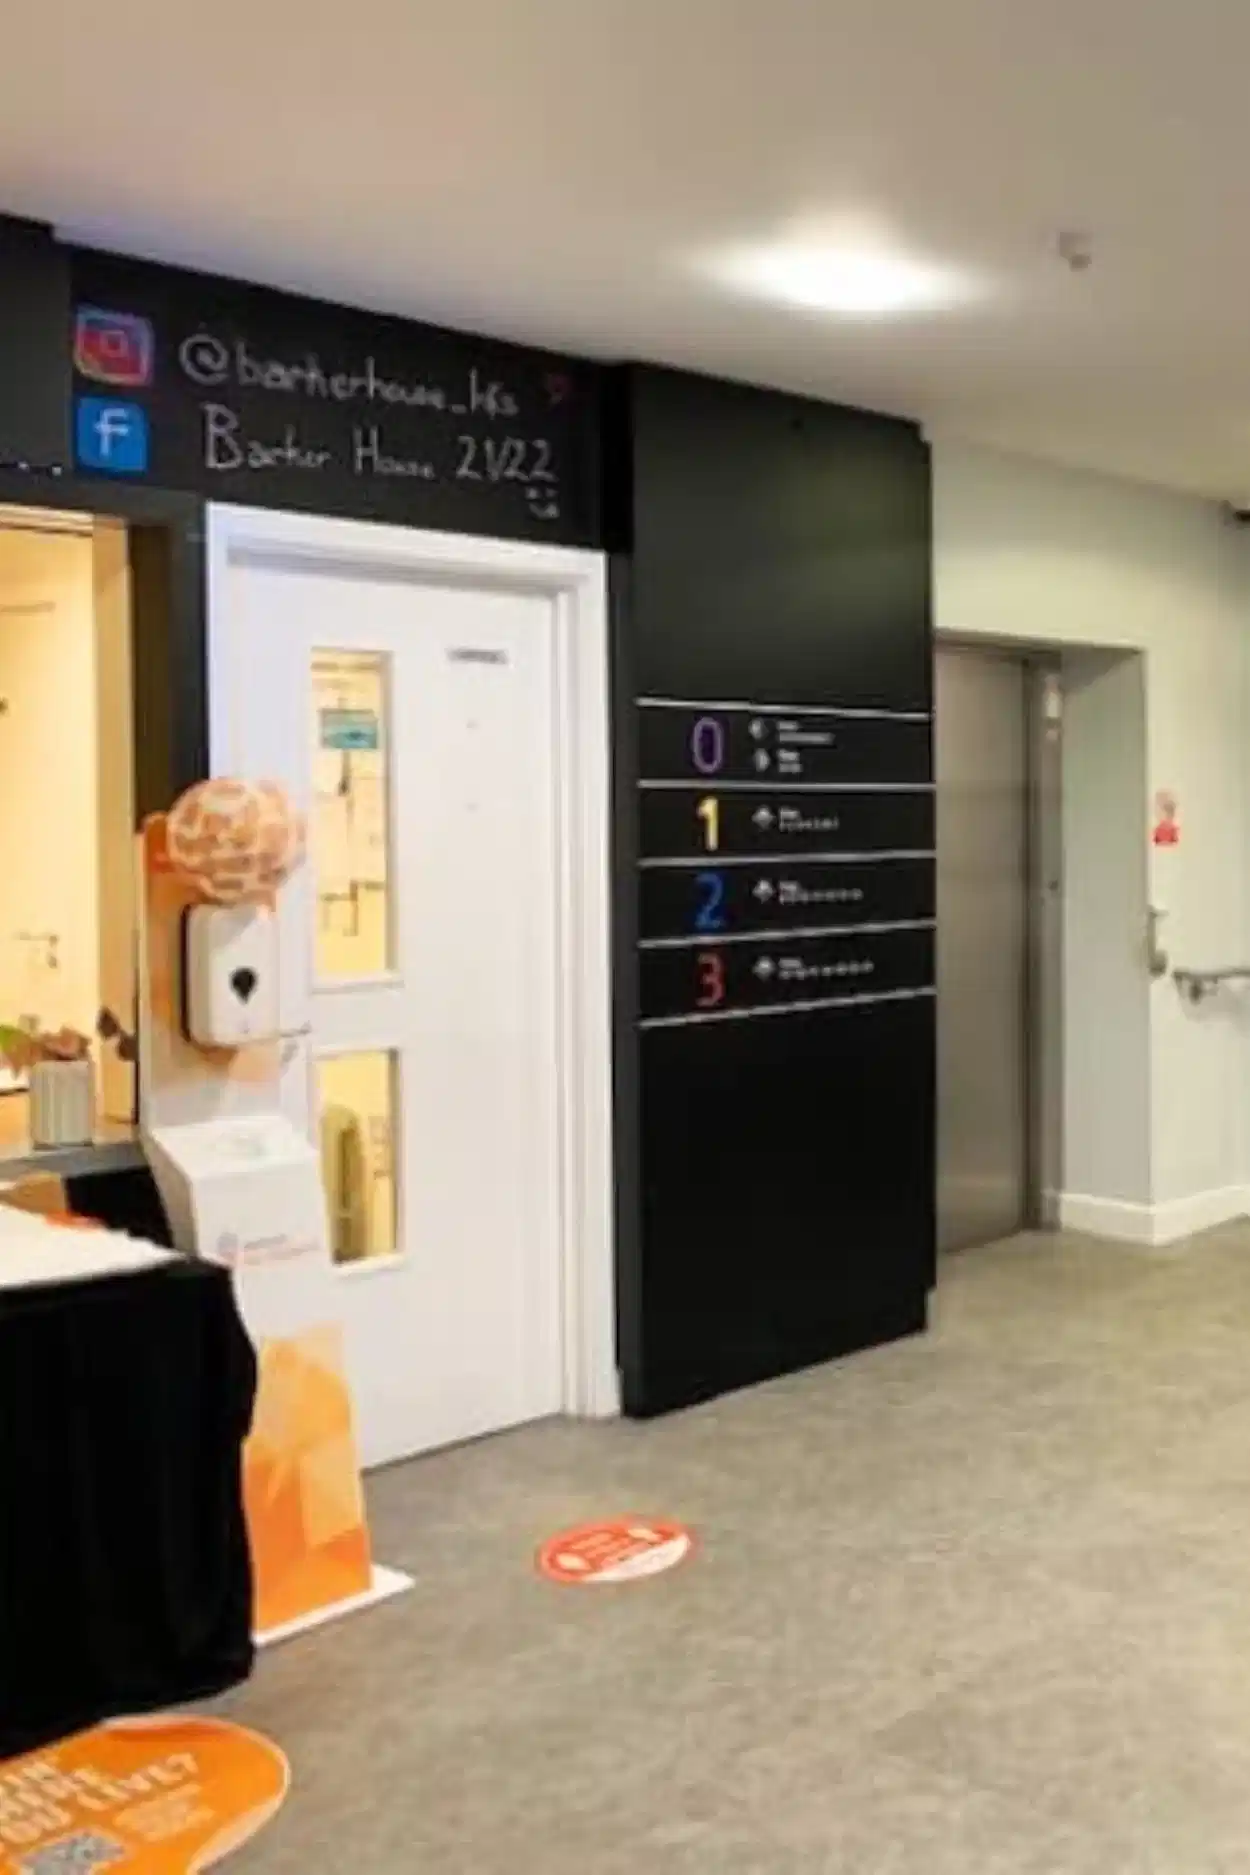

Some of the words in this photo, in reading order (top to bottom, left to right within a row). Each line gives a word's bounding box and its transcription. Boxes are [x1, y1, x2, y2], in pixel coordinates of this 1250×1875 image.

[692, 716, 724, 774] 0
[697, 796, 719, 851] 1
[694, 872, 726, 929] 2
[697, 952, 726, 1007] 3
